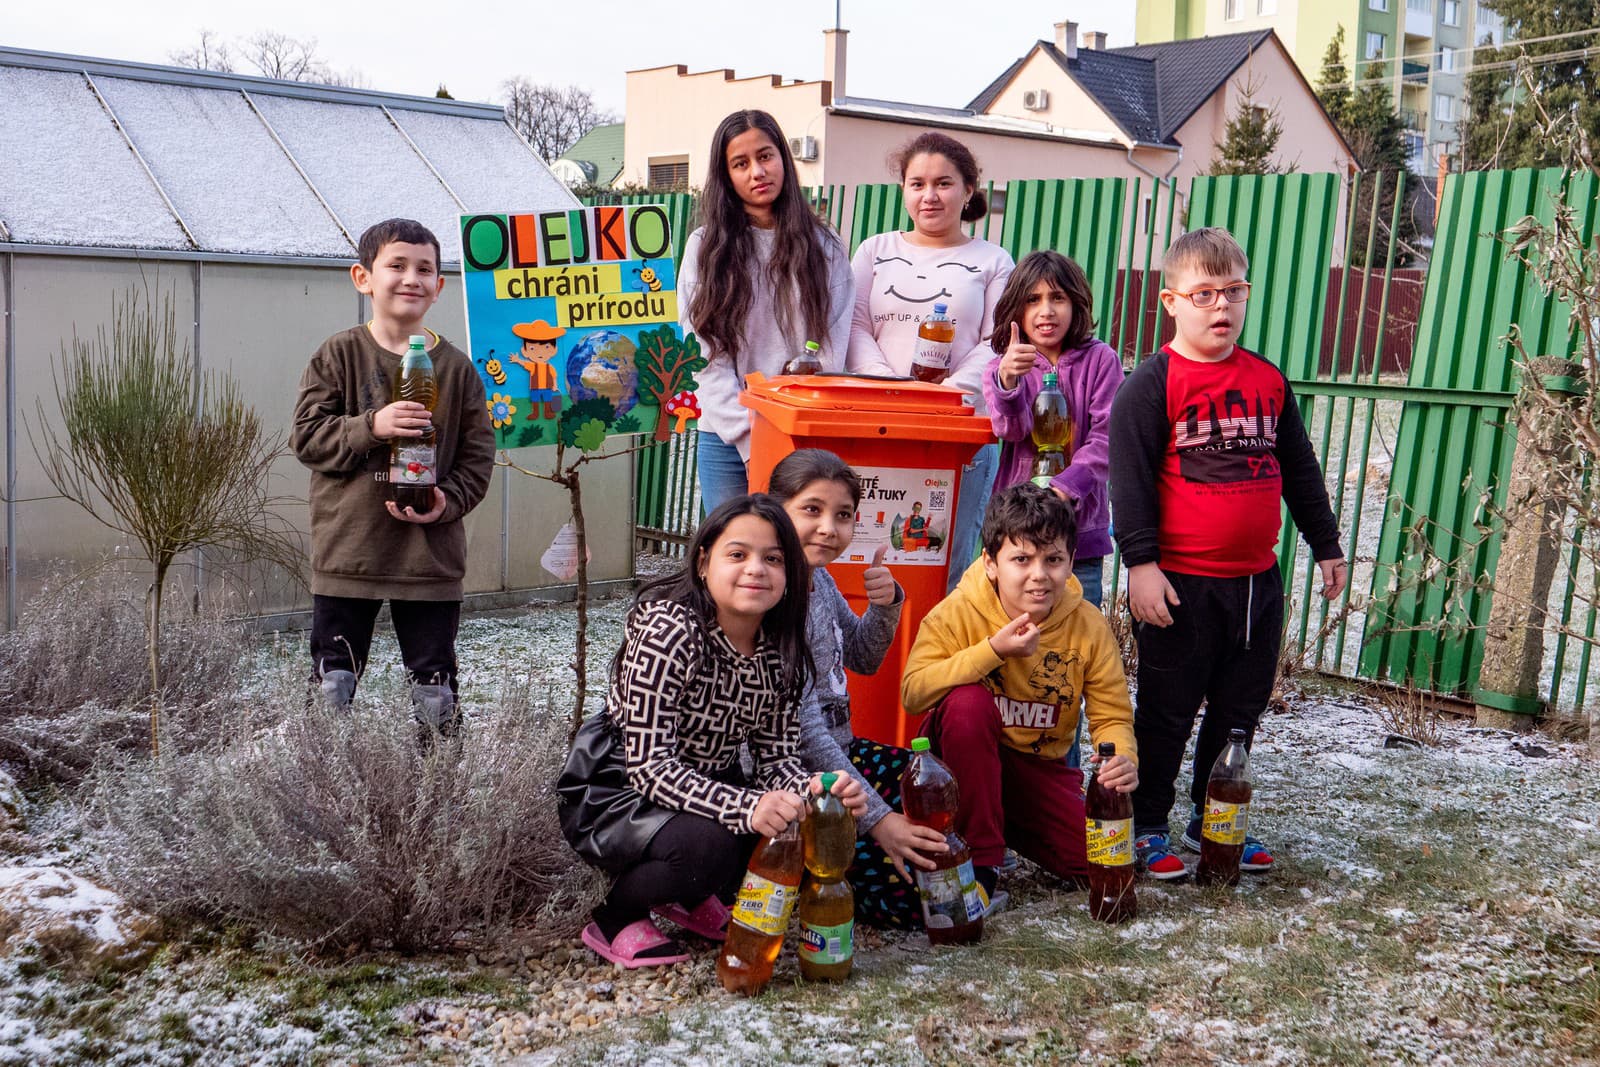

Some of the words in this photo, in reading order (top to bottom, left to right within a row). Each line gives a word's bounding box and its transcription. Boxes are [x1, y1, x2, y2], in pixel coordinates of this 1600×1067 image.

[463, 205, 670, 271] OLEJKO
[507, 267, 599, 298] chráni
[568, 294, 666, 328] prírodu
[874, 313, 895, 323] SHUT
[897, 313, 912, 322] UP
[914, 314, 920, 322] &
[924, 478, 948, 488] Olejko
[878, 489, 907, 500] TUKY
[1211, 822, 1231, 831] ZERO
[1110, 840, 1129, 856] ZERO
[741, 900, 763, 909] ZERO
[800, 930, 821, 946] udiš
